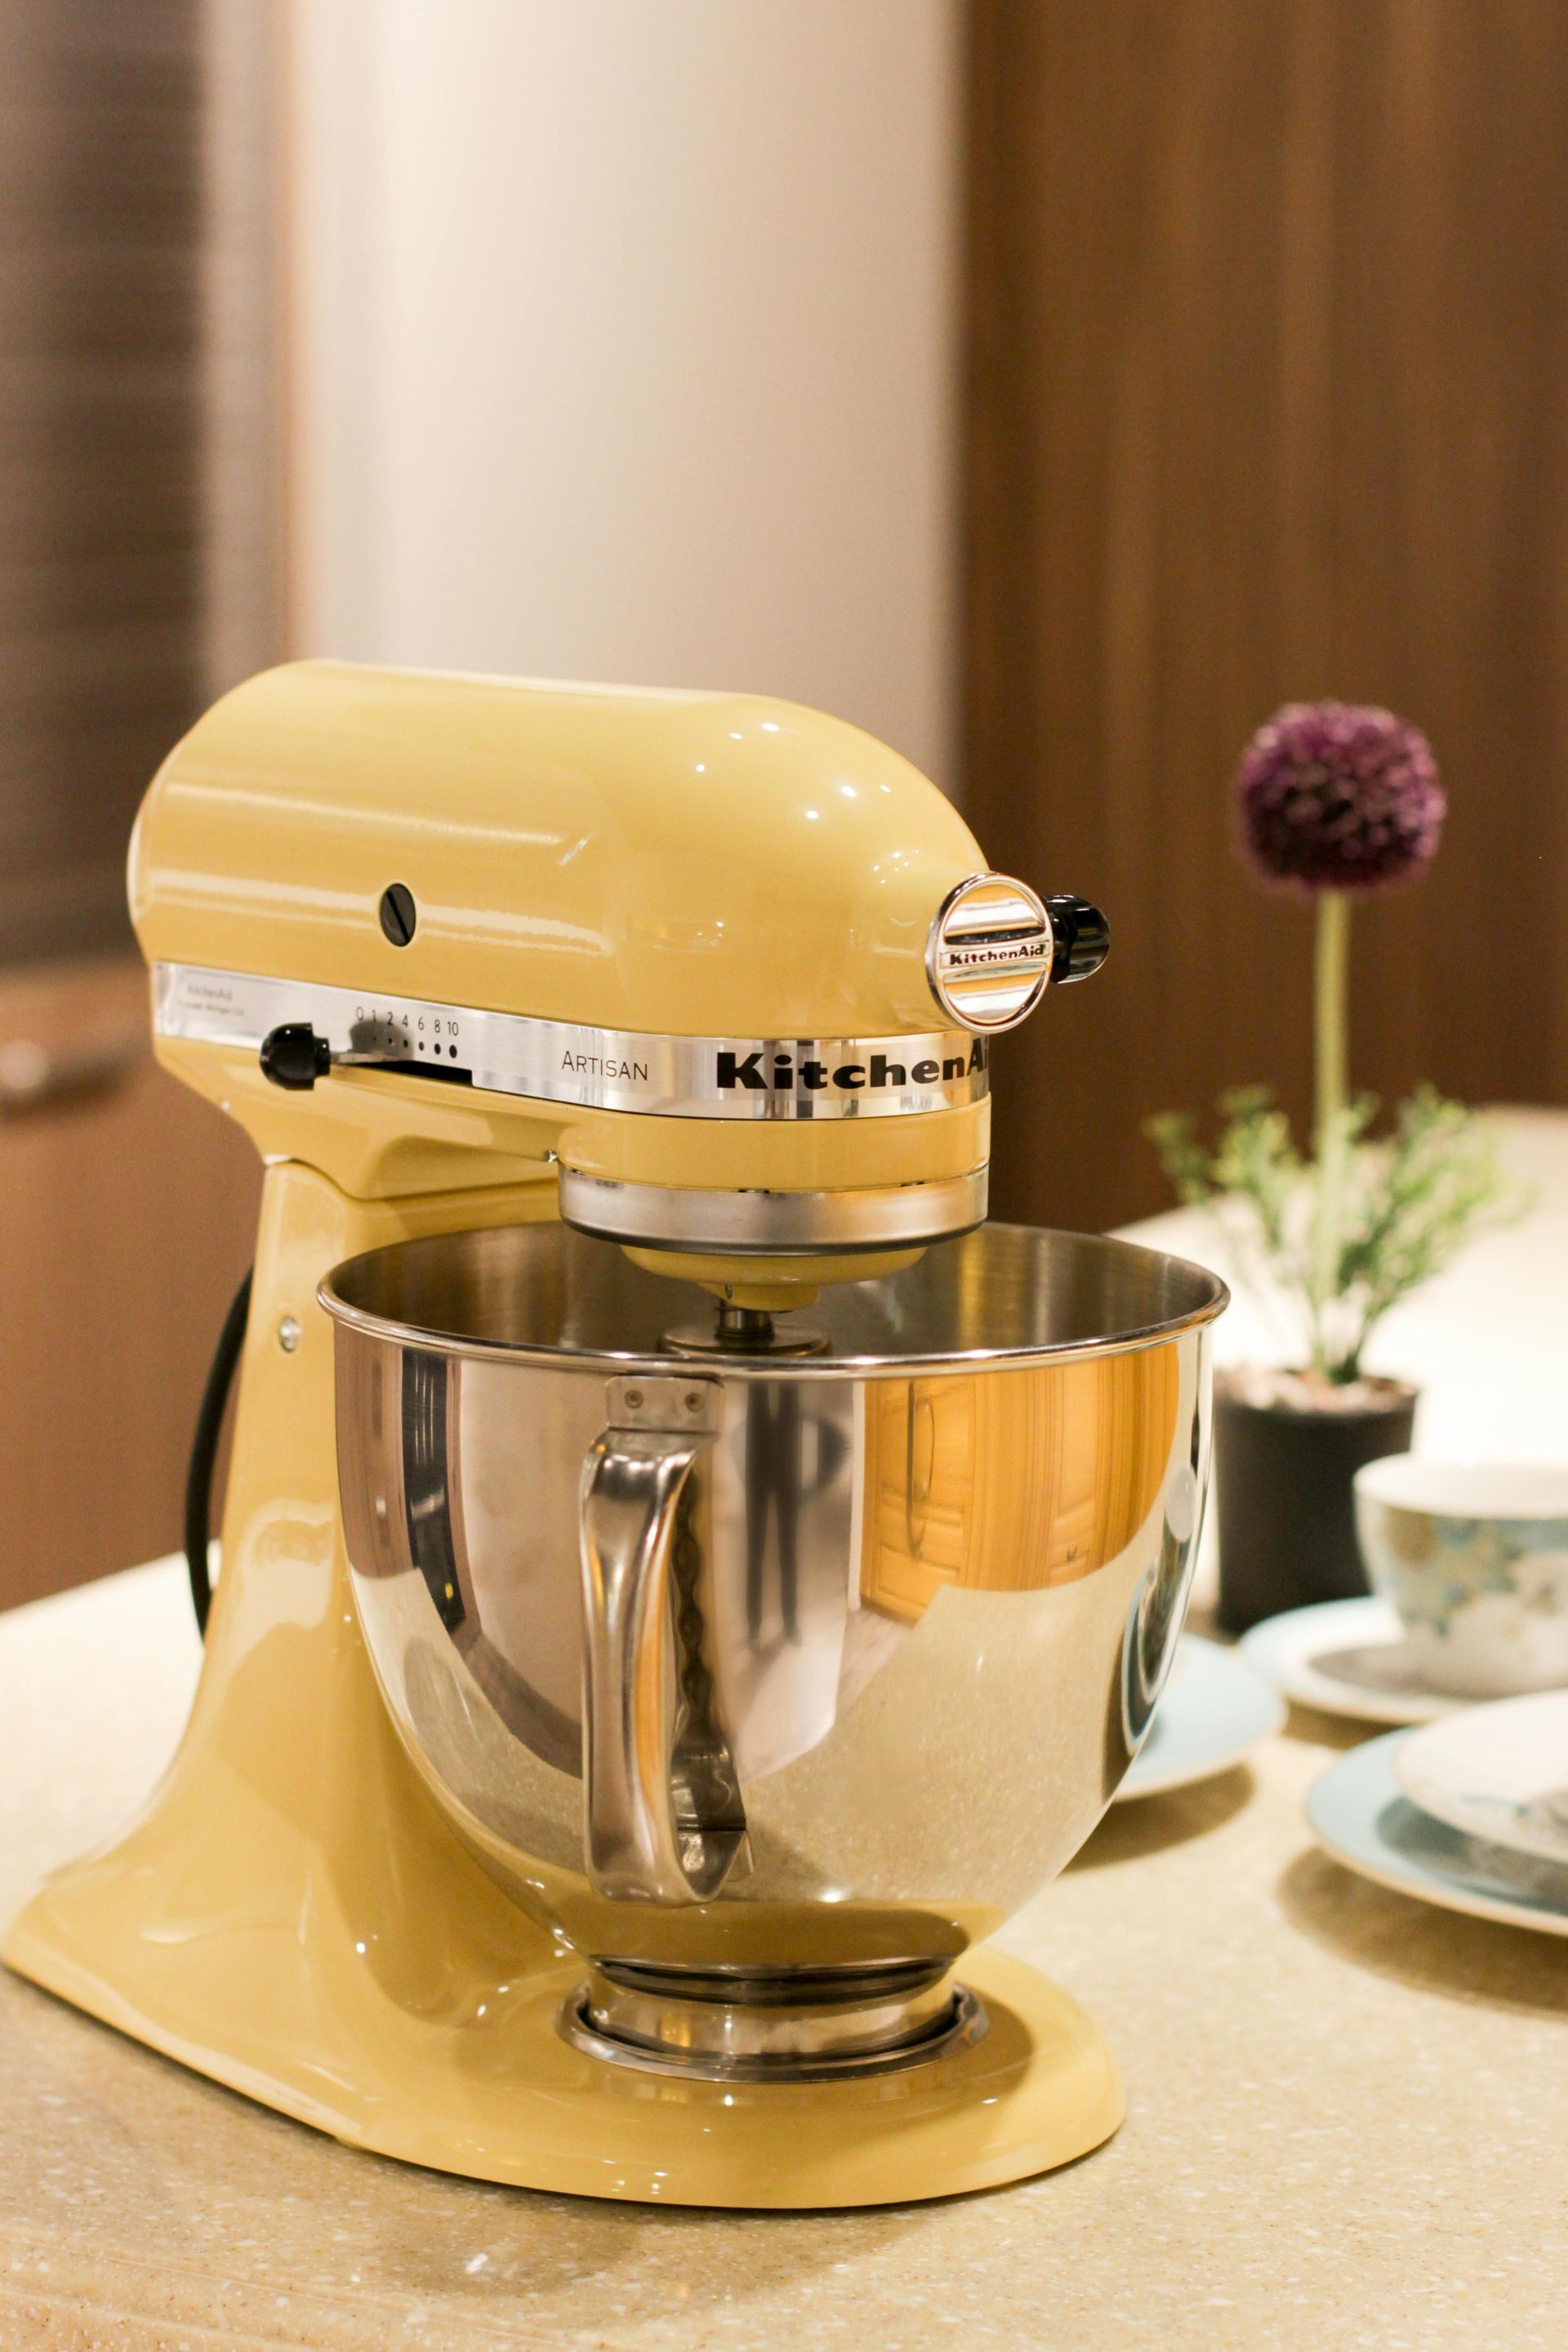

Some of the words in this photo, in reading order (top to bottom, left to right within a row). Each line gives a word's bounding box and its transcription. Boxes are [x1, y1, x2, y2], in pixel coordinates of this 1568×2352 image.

[950, 944, 1045, 965] KitchenAid
[356, 1006, 364, 1021] 0
[372, 1009, 376, 1022] 1
[387, 1011, 394, 1026] 2
[402, 1014, 408, 1027] 4
[417, 1017, 425, 1031] 6
[434, 1019, 441, 1033] 8
[448, 1021, 459, 1036] 10
[561, 1050, 648, 1081] ARTISAN
[716, 1036, 988, 1090] KitchenAi
